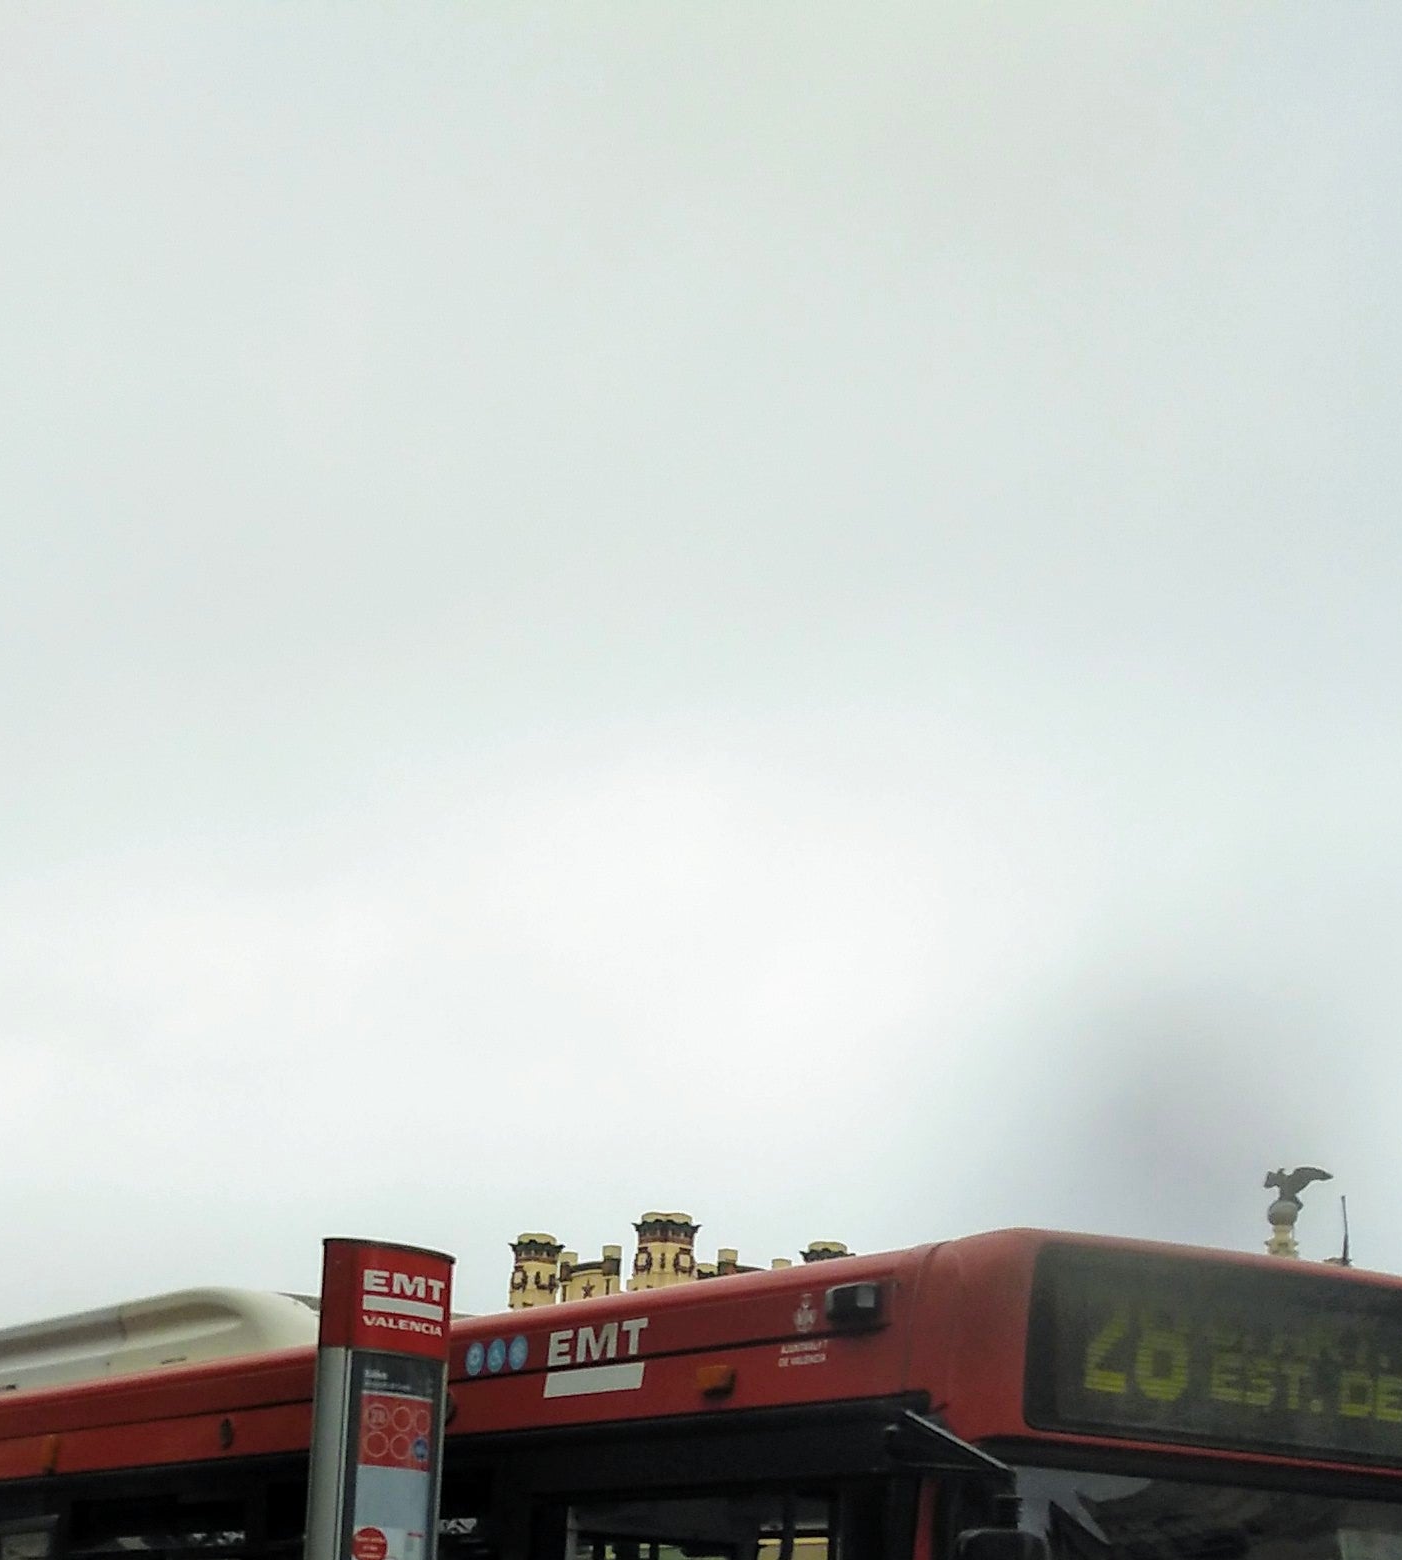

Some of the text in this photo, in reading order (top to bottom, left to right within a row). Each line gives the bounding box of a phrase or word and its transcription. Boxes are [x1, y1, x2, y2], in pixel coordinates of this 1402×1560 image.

[362, 1269, 446, 1302] EMT
[361, 1314, 443, 1338] VALENCIA
[546, 1317, 650, 1368] EMT
